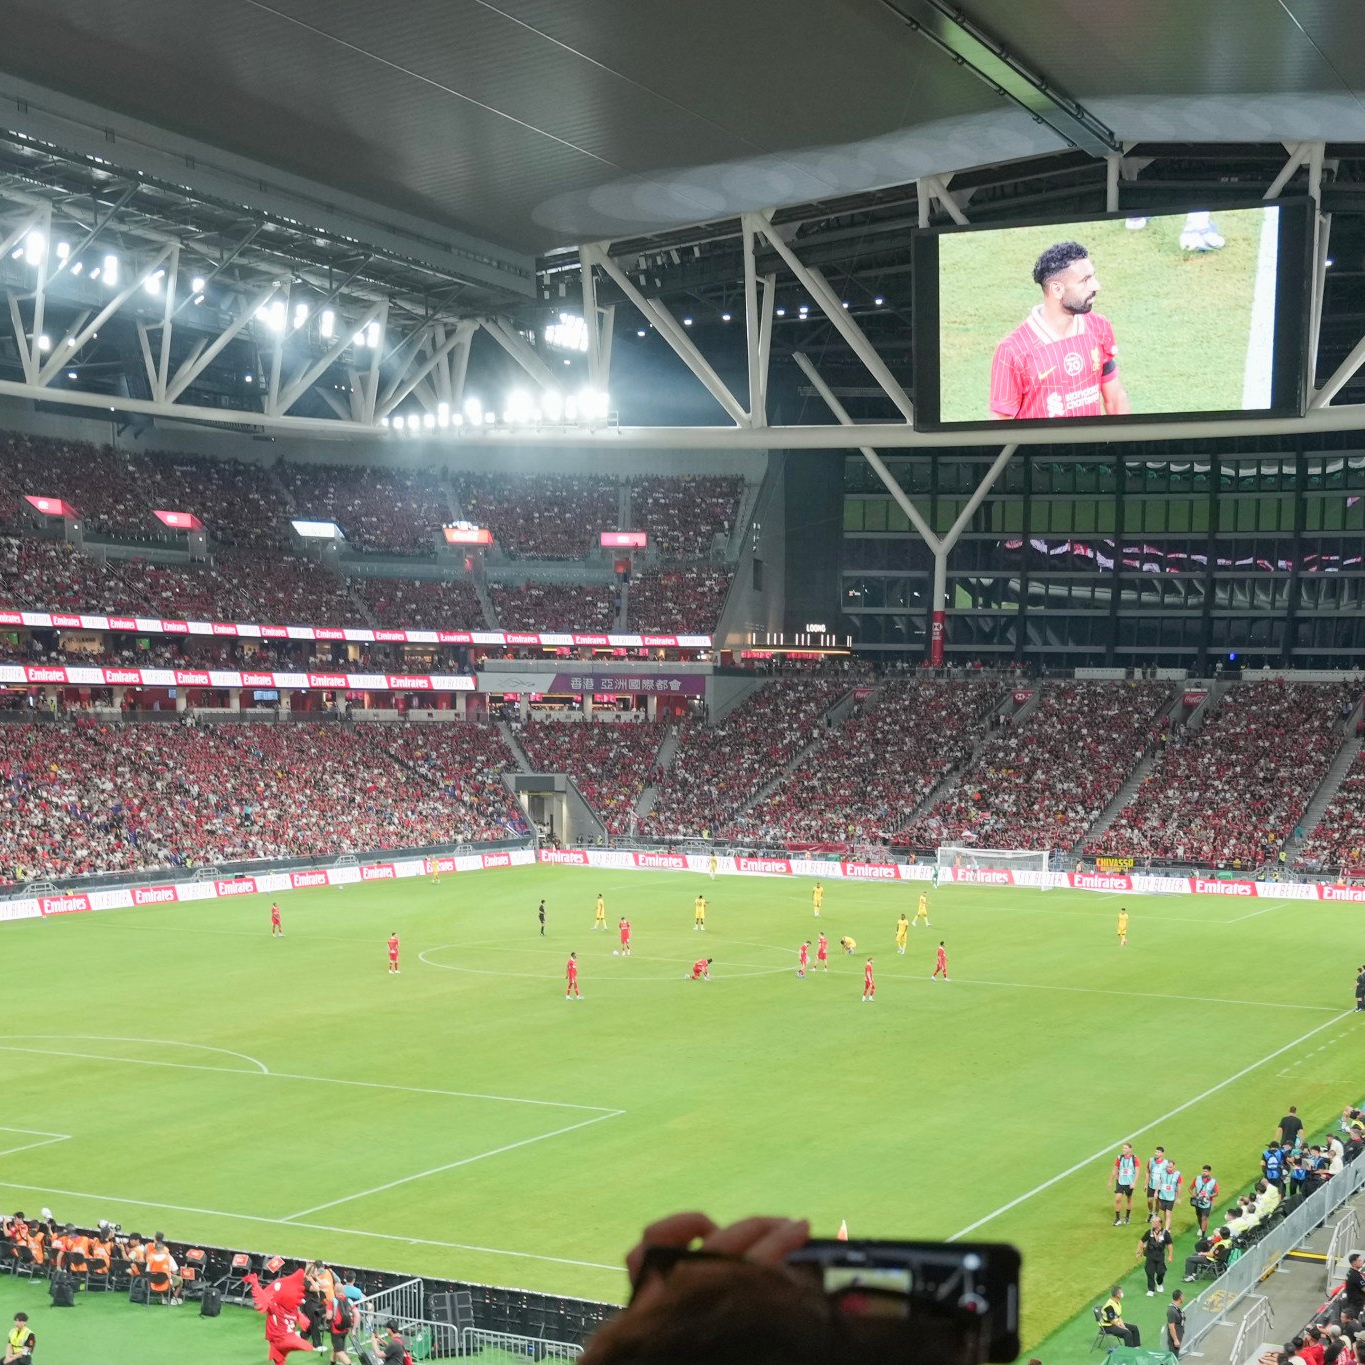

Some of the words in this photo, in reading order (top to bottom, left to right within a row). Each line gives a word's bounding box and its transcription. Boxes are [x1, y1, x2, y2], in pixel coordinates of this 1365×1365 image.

[53, 615, 80, 627] Emirates
[110, 618, 135, 630] Emirates
[29, 668, 65, 682] Emirates
[106, 670, 140, 683] Emirates
[178, 672, 209, 684] Emirates
[243, 674, 272, 685] Emirates
[311, 676, 346, 687] Emirates
[390, 677, 429, 688] Emirates
[570, 677, 595, 690] 香港
[601, 679, 683, 691] 亞洲國際都會
[485, 854, 510, 866] Emirates
[542, 851, 583, 863] Emirates
[592, 853, 604, 864] FLY
[606, 853, 629, 865] BETTER
[639, 855, 683, 867] Emirates
[692, 857, 704, 868] FLY
[1096, 857, 1133, 867] CHIVASSO
[741, 859, 786, 872] Emirates
[796, 861, 808, 872] FLY
[811, 862, 836, 874] BETTER
[846, 864, 895, 878] Emirates
[905, 866, 918, 878] FLY
[363, 866, 393, 879] Emirates
[1016, 871, 1030, 884] FLY
[294, 873, 326, 887] Emirates
[1074, 875, 1126, 889] Emirates
[1138, 878, 1151, 890] FLY
[1155, 878, 1183, 891] BETTER
[219, 882, 254, 896] Emirates
[1196, 880, 1251, 895] Emirates
[1263, 883, 1278, 896] FLY
[1282, 884, 1310, 897] BETTER
[136, 890, 173, 903] Emirates
[43, 898, 86, 914] Emirates
